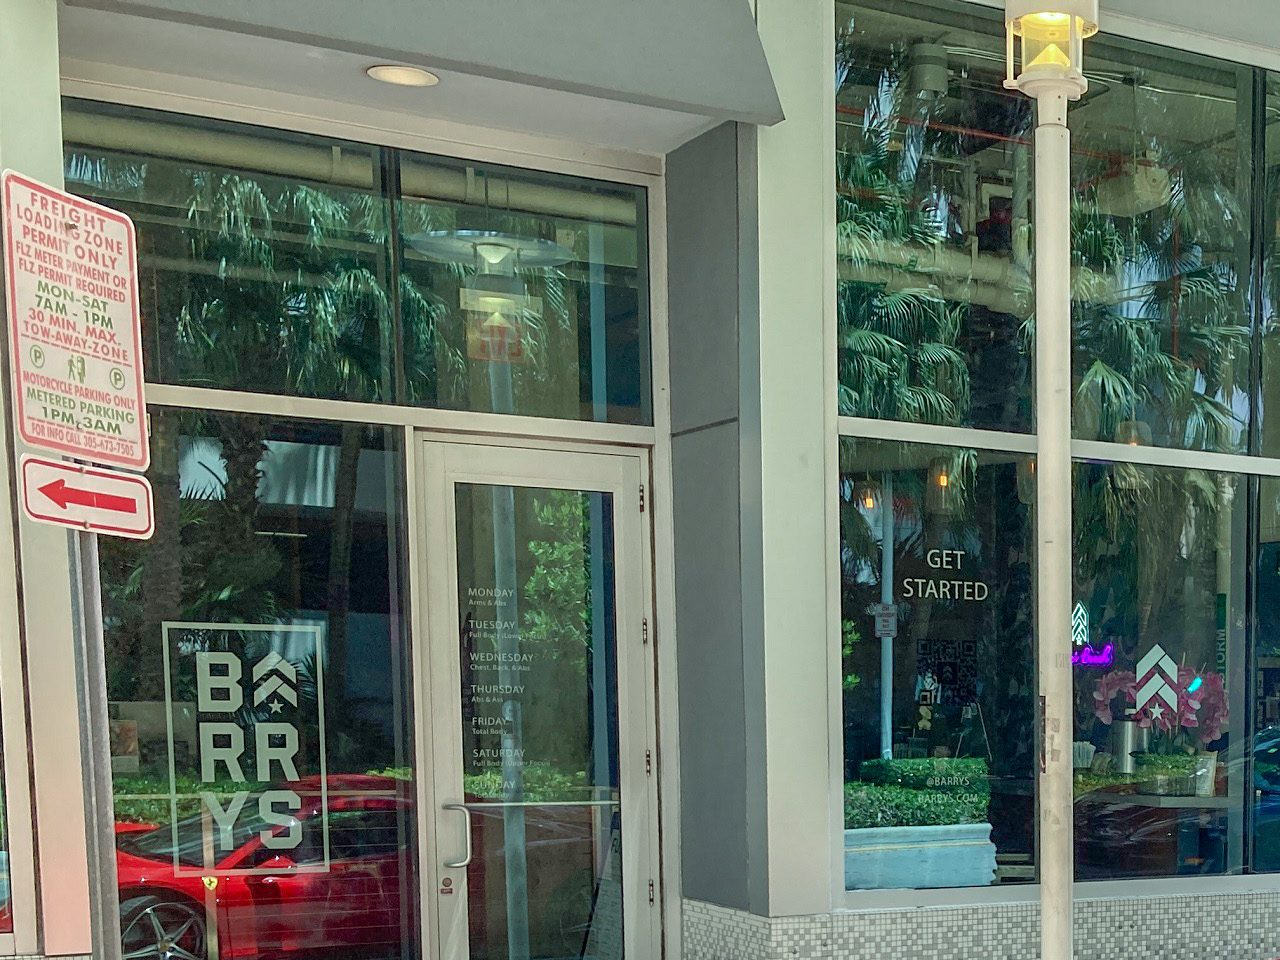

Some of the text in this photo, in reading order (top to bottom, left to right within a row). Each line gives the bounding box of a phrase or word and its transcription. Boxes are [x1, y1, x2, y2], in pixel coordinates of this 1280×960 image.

[30, 192, 105, 232] FREIGHT
[17, 203, 123, 255] LOADING ZONE
[23, 225, 117, 270] PERMIT ONLY
[16, 240, 127, 290] FLZ METER PAYMENT OR
[19, 257, 125, 303] FLZ PERMIT REQUIRED
[37, 280, 108, 313] MON-SAT
[35, 294, 68, 316] 7AM
[84, 310, 113, 330] 1PM
[29, 307, 121, 346] 30 MIN. MAX.
[24, 320, 128, 361] TOW-AWAY-ZONE
[23, 370, 135, 411] MOTORCYCLE PARKING ONLY
[27, 387, 135, 424] METERED PARKING
[31, 422, 45, 436] FOR
[47, 425, 64, 441] INFO
[66, 431, 81, 446] CALL
[926, 549, 965, 569] GET
[468, 587, 514, 597] MONDAY
[903, 578, 988, 600] STARTED
[469, 620, 515, 629] TUESDAY
[470, 652, 533, 661] WEDNESDAY
[470, 684, 525, 694] THURSDAY
[472, 717, 507, 725] FRIDAY
[490, 728, 507, 736] Body
[473, 749, 525, 758] SATURDAY
[474, 780, 515, 790] SUNDAY
[926, 776, 970, 787] @BARRYS
[918, 793, 978, 804] BARRYS.COM
